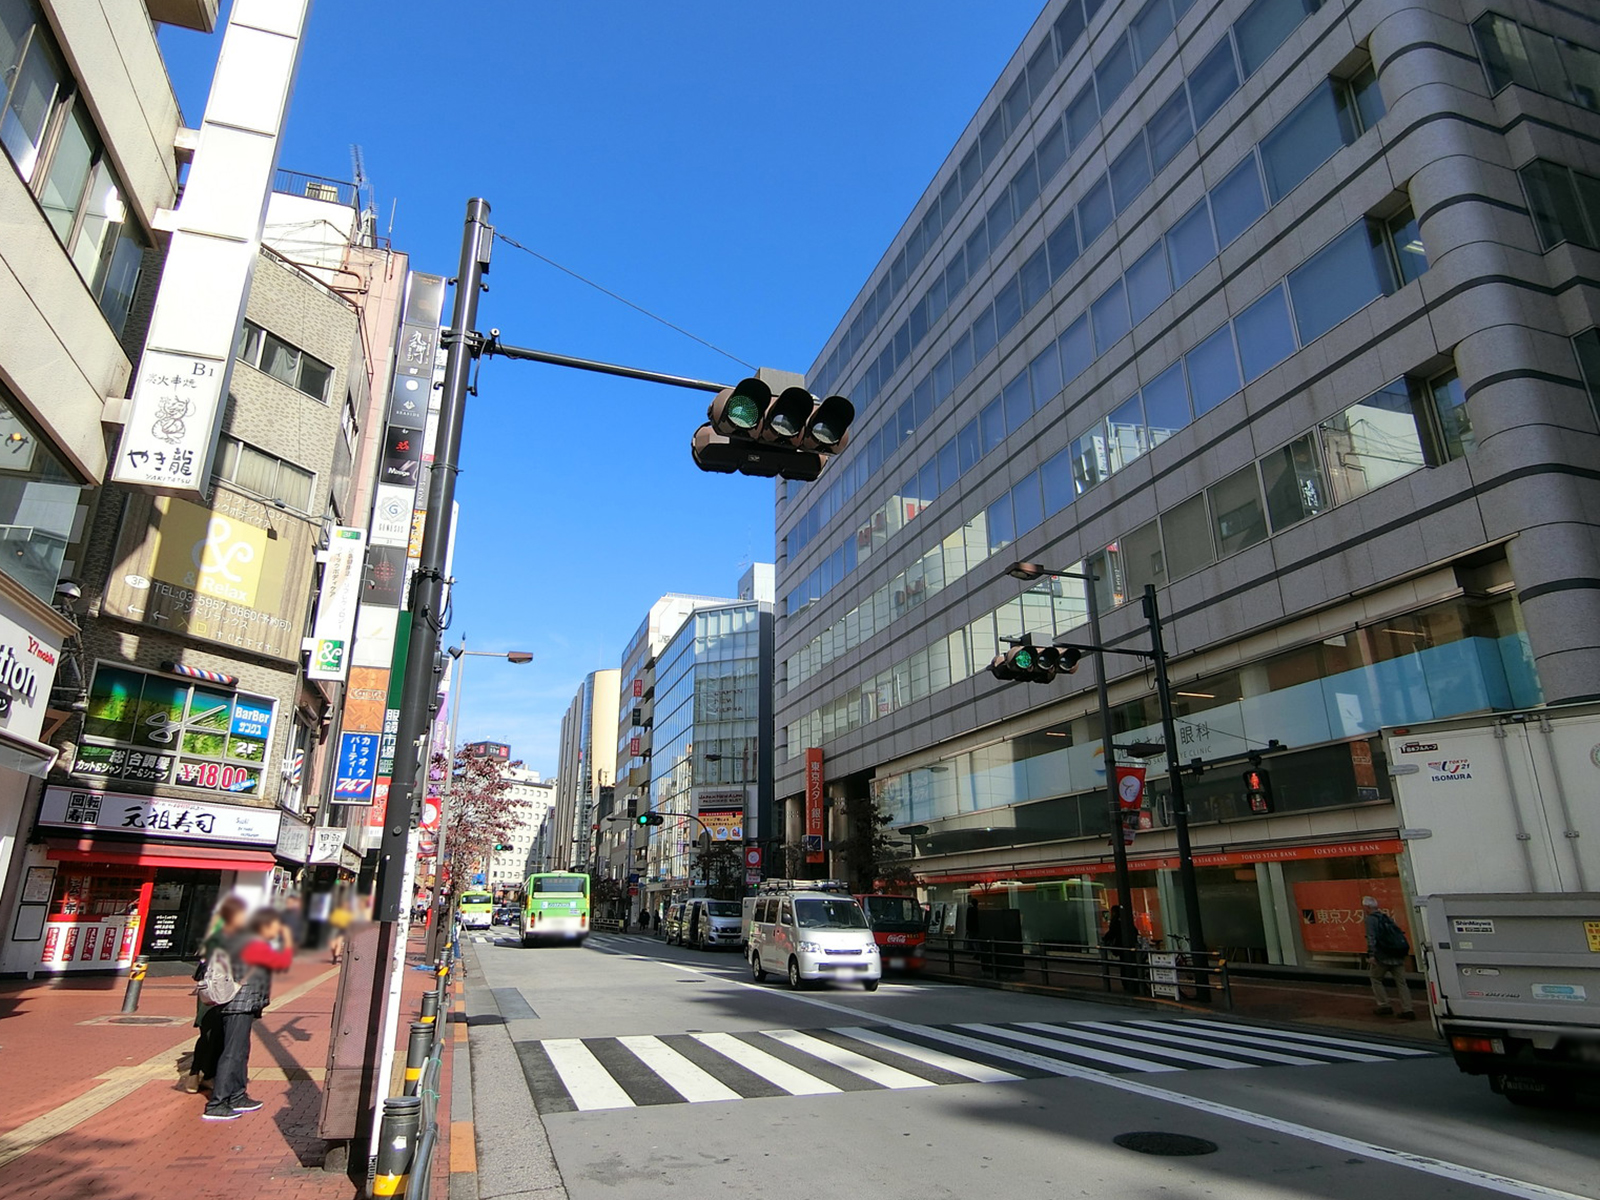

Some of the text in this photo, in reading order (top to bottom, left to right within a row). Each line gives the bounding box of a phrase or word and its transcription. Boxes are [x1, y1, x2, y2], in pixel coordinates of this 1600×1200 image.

[127, 447, 194, 476] やき龍
[131, 576, 145, 587] 3F
[201, 576, 249, 603] Relax
[235, 708, 270, 723] BarBer
[381, 708, 400, 759] 眼鏡市場
[1180, 720, 1211, 746] 眼科
[235, 741, 259, 754] 2F
[348, 736, 361, 776] パーティー
[356, 736, 371, 777] カラオケ
[1188, 745, 1213, 757] CLINIC
[108, 749, 171, 770] 総合調髪
[335, 777, 372, 793] 747
[1431, 773, 1472, 782] ISOMURA
[811, 761, 821, 829] 東京スター銀行
[121, 805, 217, 834] 元祖寿司
[1241, 853, 1262, 861] TOKYO
[1263, 852, 1278, 860] STAR
[1313, 844, 1381, 855] TOKYO STAR BANK
[1212, 855, 1229, 863] BANK
